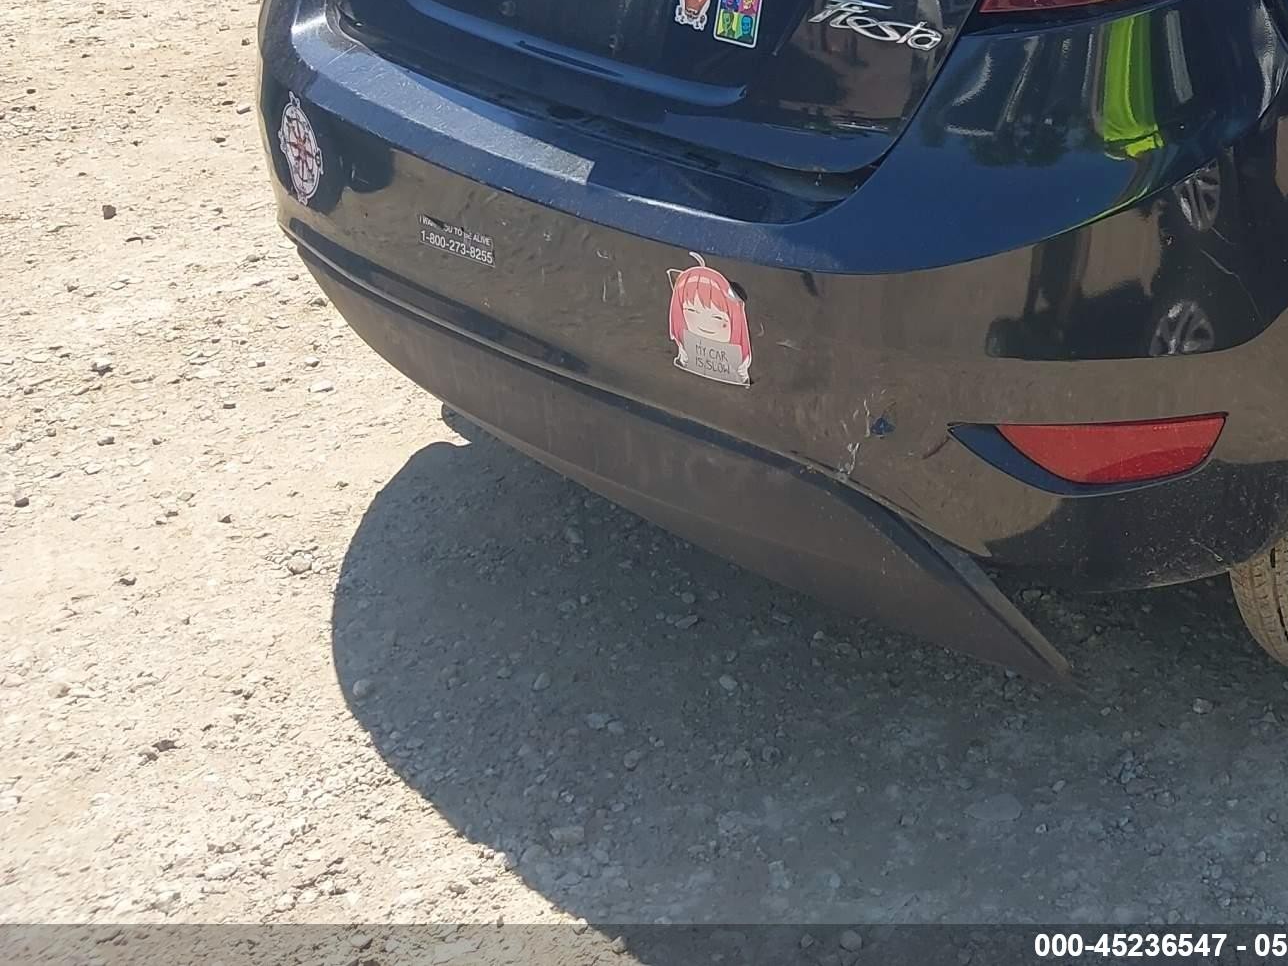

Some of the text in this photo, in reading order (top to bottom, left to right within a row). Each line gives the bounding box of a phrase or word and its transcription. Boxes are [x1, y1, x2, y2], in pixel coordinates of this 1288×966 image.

[454, 227, 463, 237] TO
[473, 233, 491, 246] ALIVE
[421, 230, 493, 264] 1-800-273-8255
[695, 344, 729, 362] MY CAR
[695, 356, 730, 375] IS SLOW
